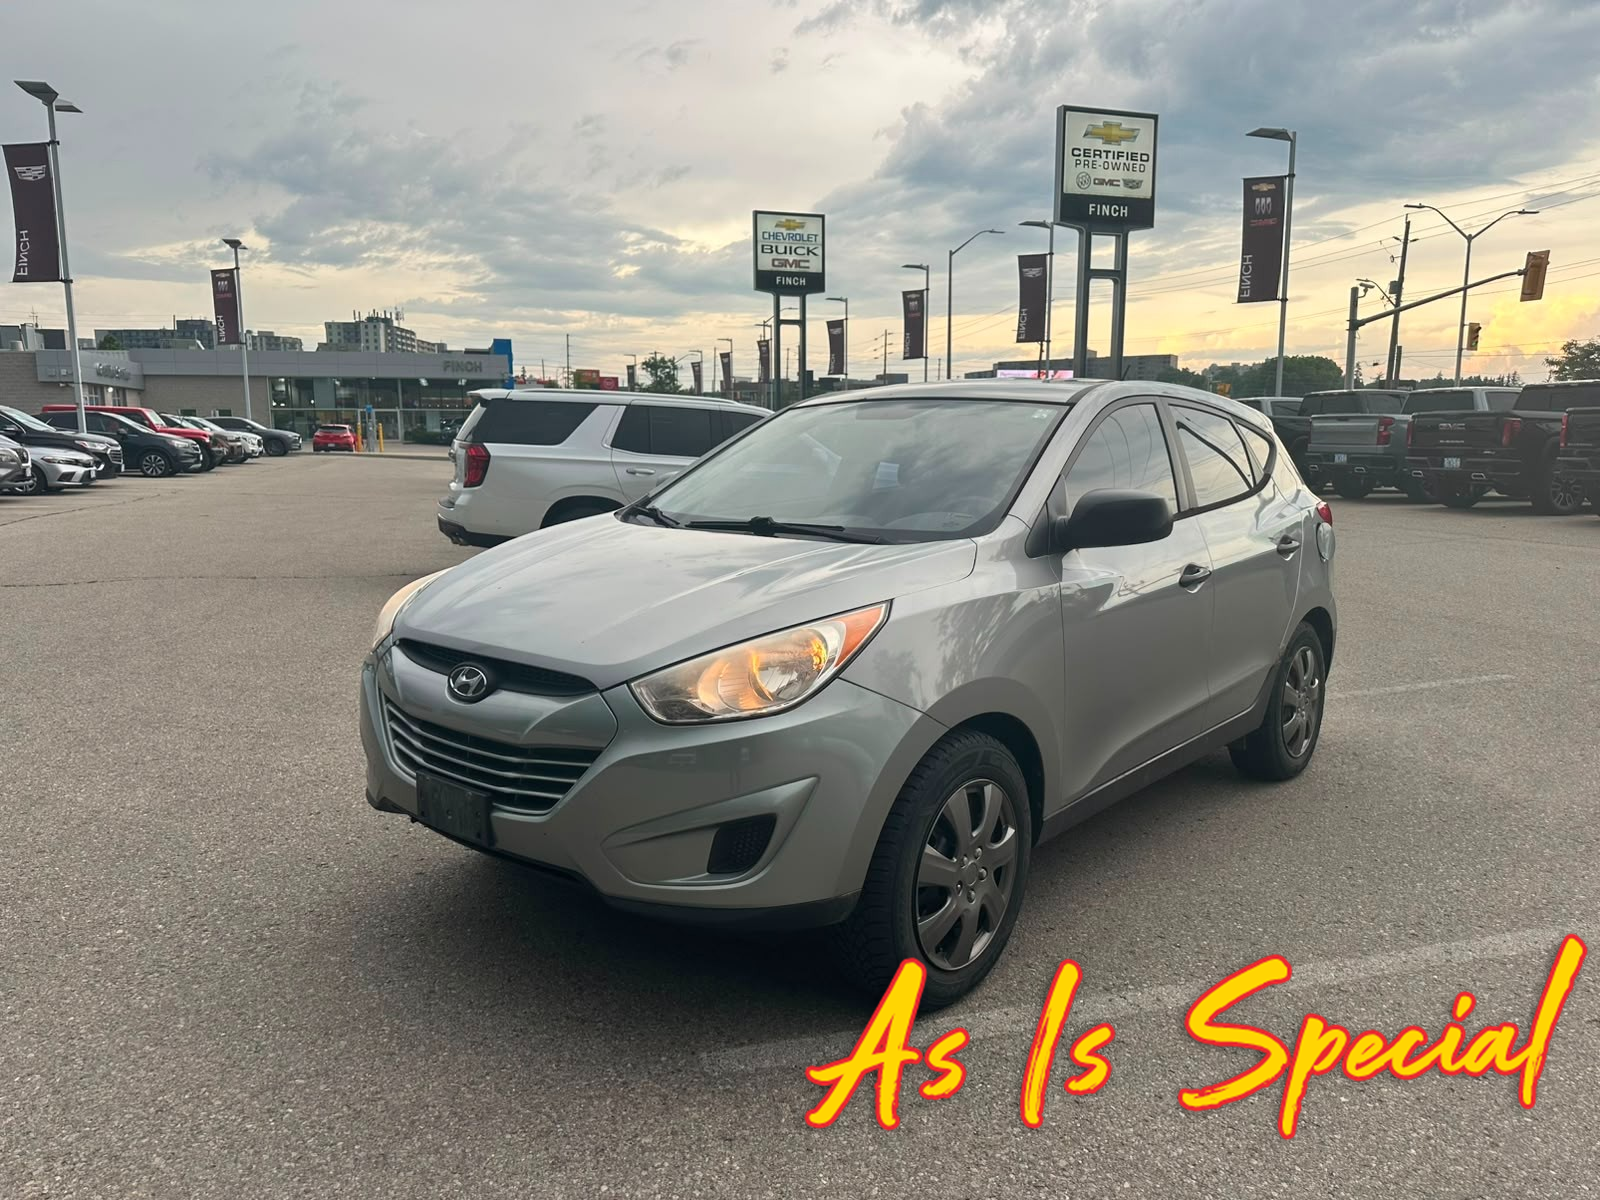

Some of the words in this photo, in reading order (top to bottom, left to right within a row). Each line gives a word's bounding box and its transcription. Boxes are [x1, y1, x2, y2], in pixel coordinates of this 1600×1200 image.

[1071, 147, 1150, 163] CERTIFIED
[1074, 159, 1146, 173] PRE-OWNED
[1093, 177, 1121, 187] GMC
[1088, 203, 1128, 217] FINCH
[762, 231, 819, 242] CHEVROLET
[761, 244, 819, 256] BUICK
[771, 258, 810, 269] GMC
[776, 276, 806, 286] FINCH
[443, 360, 482, 373] FINCH
